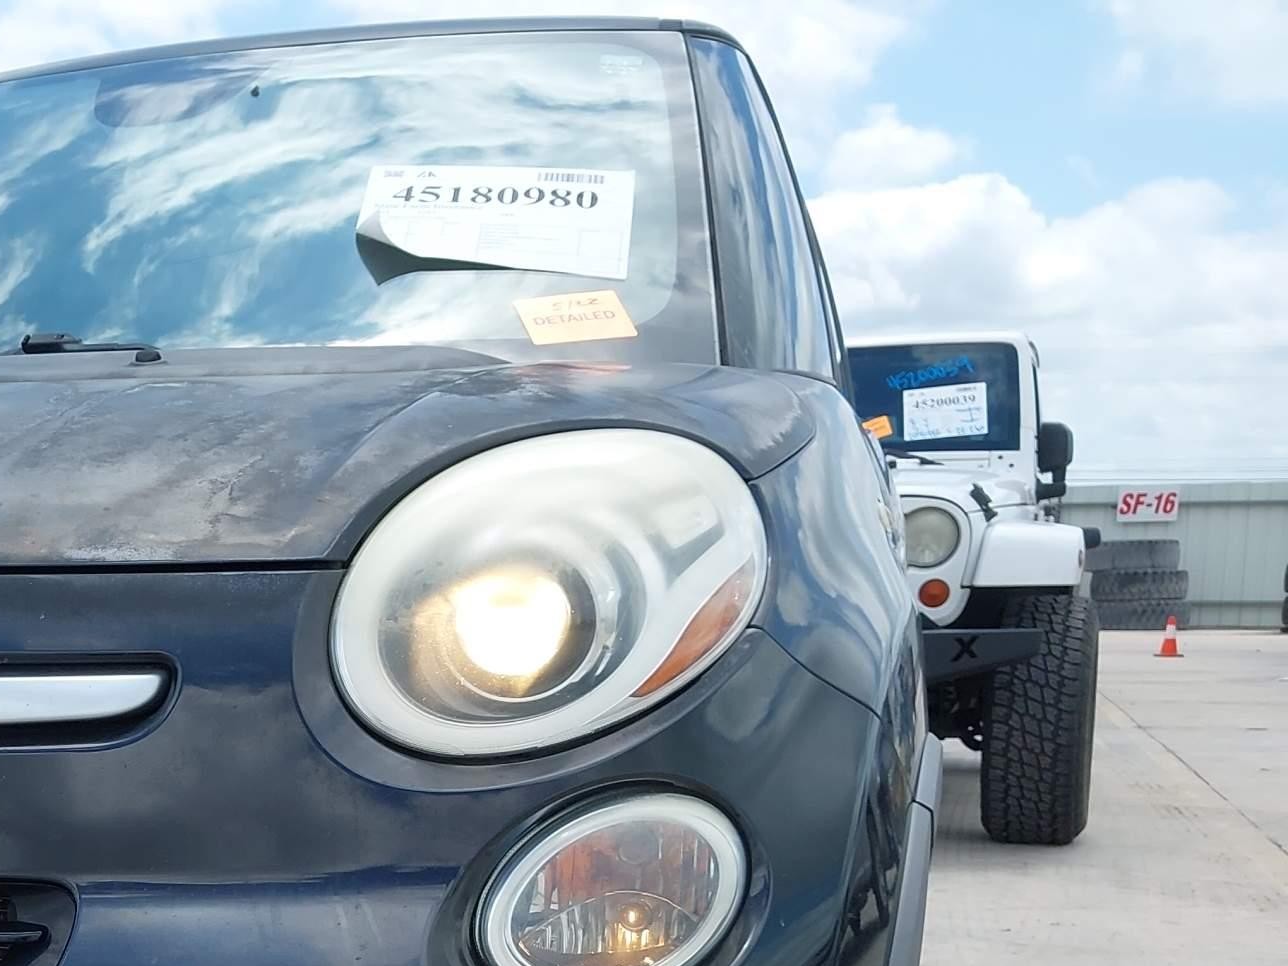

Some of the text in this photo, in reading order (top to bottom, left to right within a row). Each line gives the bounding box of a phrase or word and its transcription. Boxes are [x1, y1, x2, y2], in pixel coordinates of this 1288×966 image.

[392, 185, 598, 209] 45180980
[532, 310, 616, 326] DETAILED
[1119, 492, 1177, 516] SF-16
